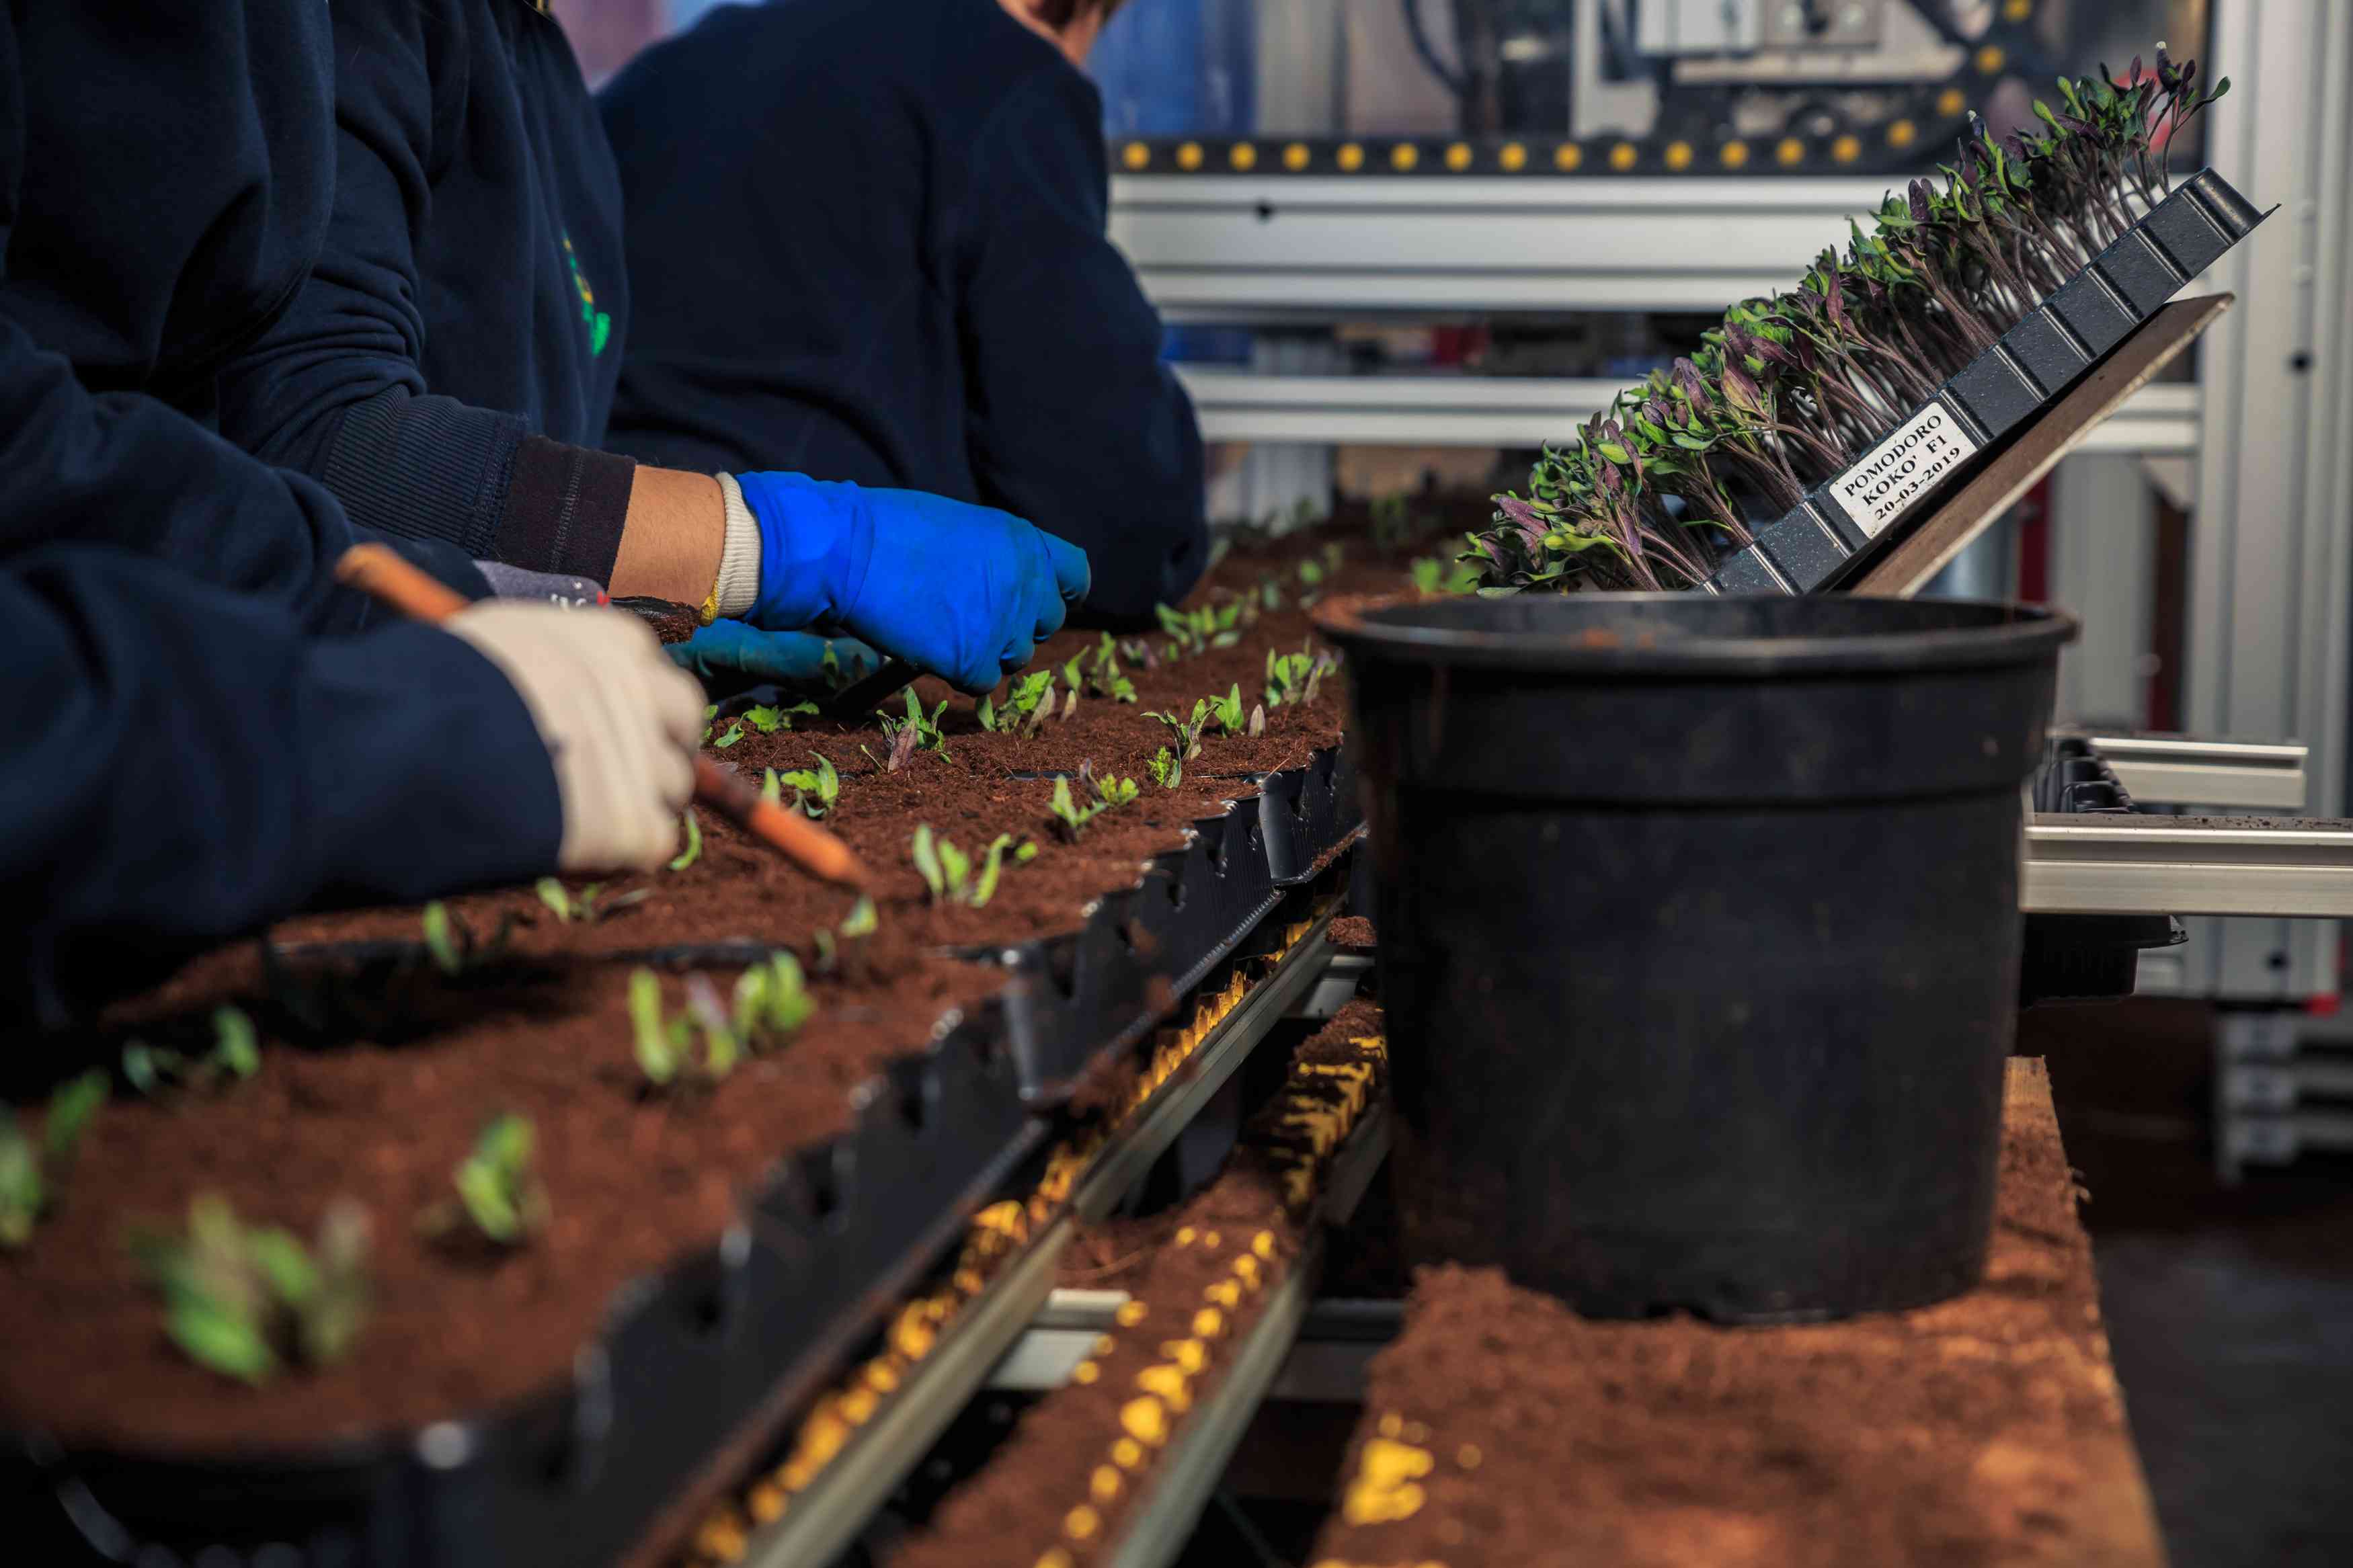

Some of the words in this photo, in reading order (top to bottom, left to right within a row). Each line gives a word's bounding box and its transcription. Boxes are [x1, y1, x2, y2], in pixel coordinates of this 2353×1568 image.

[1845, 415, 1941, 497] POMODORO
[1927, 435, 1947, 454] F1
[1875, 447, 1960, 520] 20-03-2019
